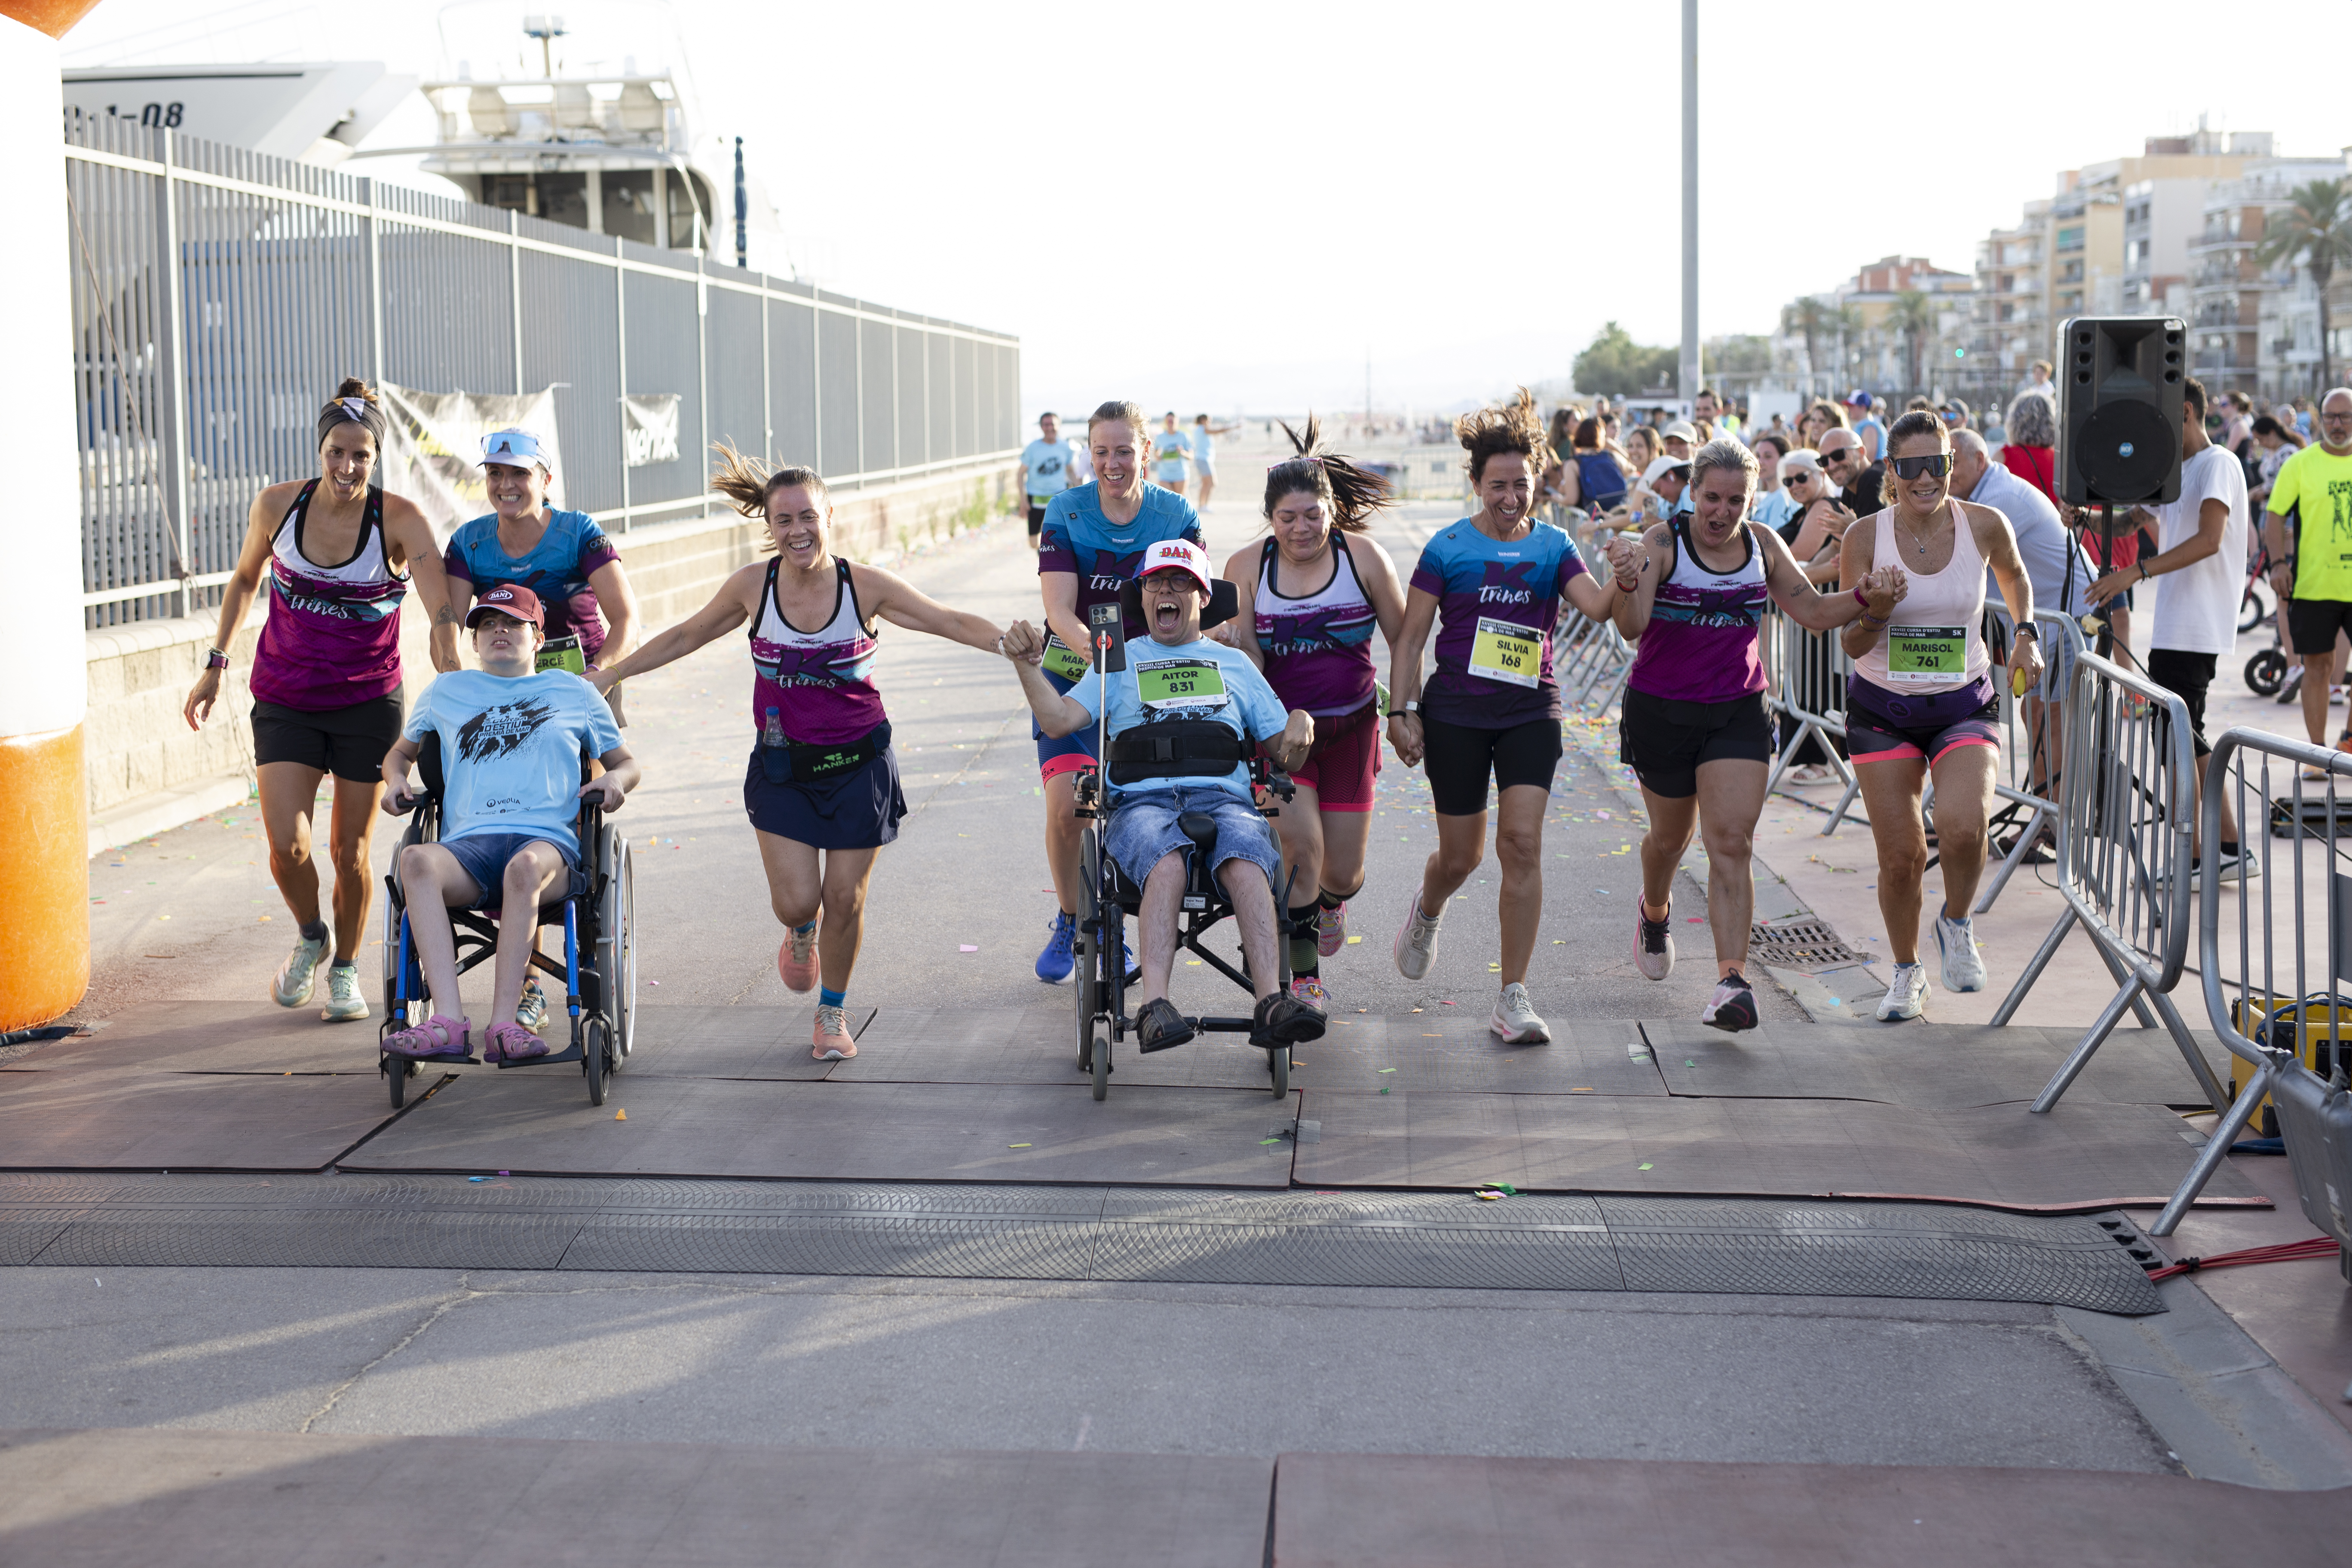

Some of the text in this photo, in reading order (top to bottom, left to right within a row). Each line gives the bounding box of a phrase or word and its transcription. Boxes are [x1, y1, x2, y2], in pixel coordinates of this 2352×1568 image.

[490, 591, 508, 599] DANI
[1478, 585, 1531, 604] trines
[288, 594, 348, 619] trines
[1497, 640, 1528, 655] SILVIA
[1902, 643, 1953, 652] MARISOL
[536, 654, 565, 668] ERCÈ
[1501, 653, 1521, 668] 168
[1917, 656, 1939, 667] 761
[775, 674, 836, 688] trines
[1162, 671, 1199, 680] AITOR
[1170, 681, 1194, 692] 831
[484, 720, 523, 732] D'ESTIU
[813, 754, 859, 772] HANKER
